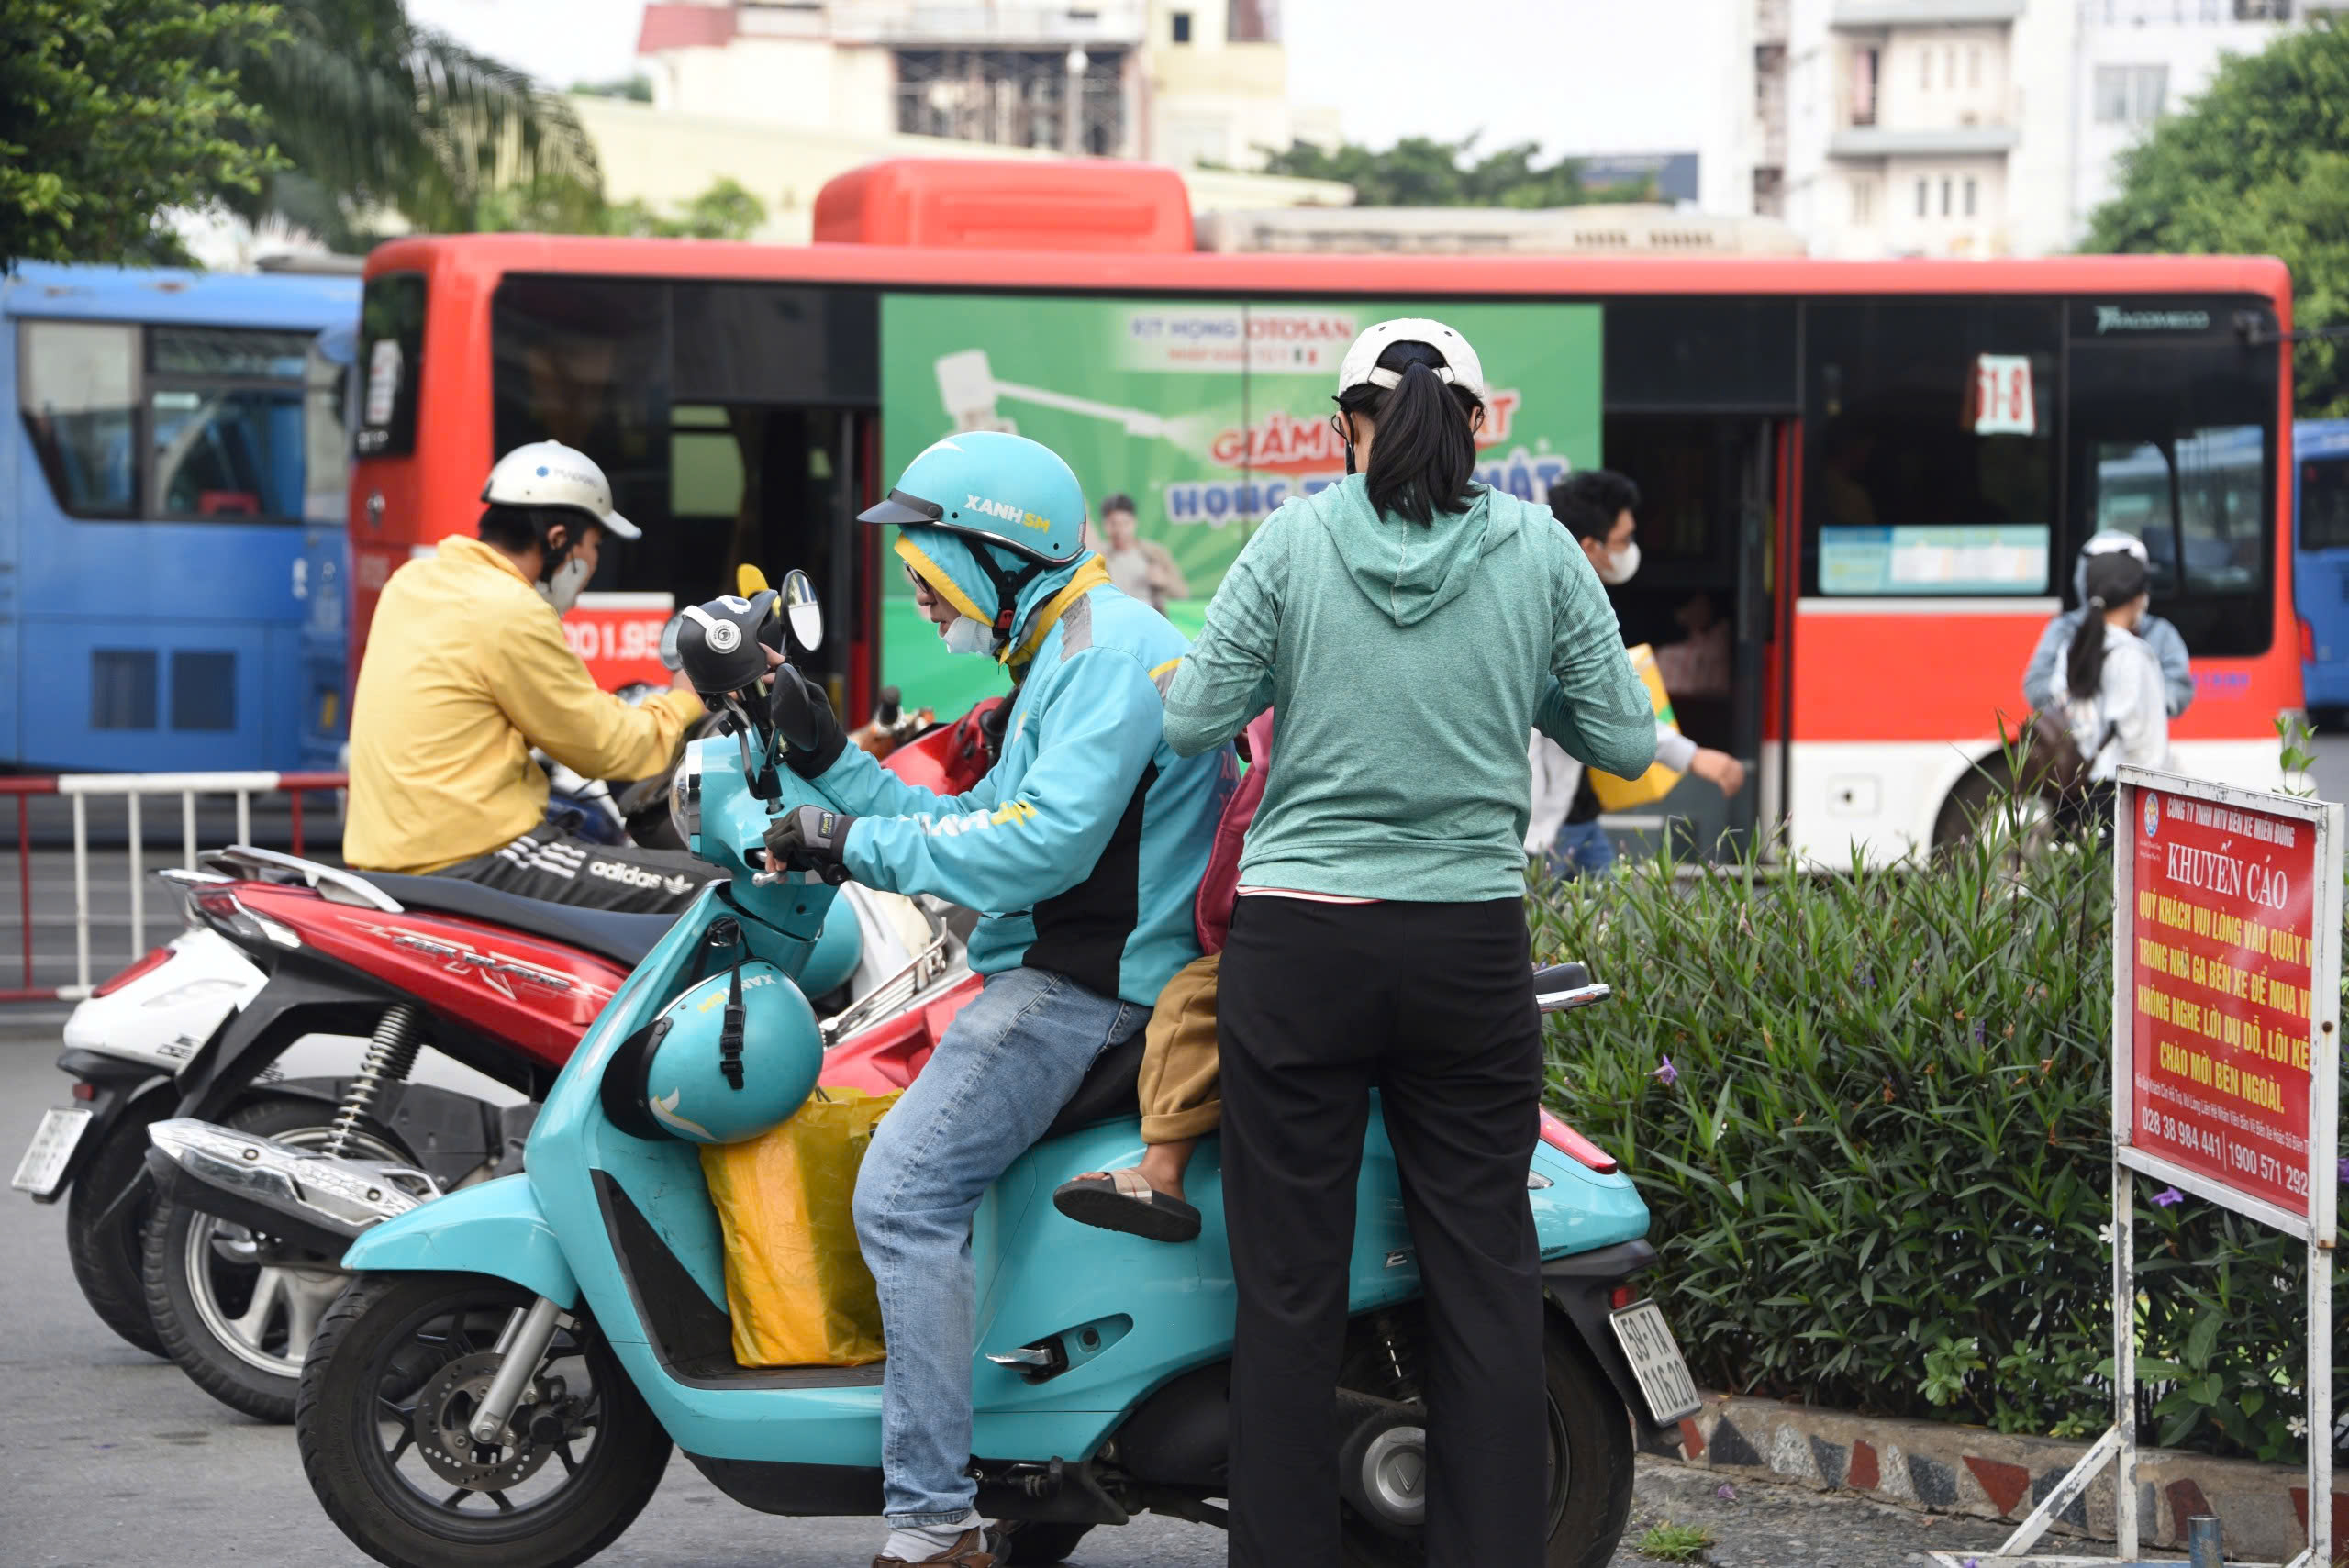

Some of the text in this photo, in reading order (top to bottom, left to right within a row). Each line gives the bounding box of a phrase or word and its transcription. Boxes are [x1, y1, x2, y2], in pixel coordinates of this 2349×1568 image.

[963, 494, 1024, 524] XANH
[589, 861, 662, 889] adidas
[2166, 840, 2288, 910] KHUYẾN CÁO
[2139, 887, 2157, 922] QUÝ
[2158, 894, 2191, 932] KHÁCH
[2193, 905, 2211, 938] VUI
[2212, 906, 2243, 948] LÒNG
[2244, 917, 2267, 955] VÀO
[2138, 936, 2167, 974] TRONG
[2192, 955, 2207, 986] GA
[2209, 953, 2231, 994] BẾN
[2232, 967, 2249, 1000] XE
[2250, 965, 2268, 1006] ĐỂ
[2268, 979, 2297, 1016] MUA
[2137, 984, 2169, 1023] KHÔNG
[2171, 996, 2200, 1033] NGHE
[2203, 1003, 2221, 1040] LỜI
[2224, 1014, 2241, 1053] DỤ
[2267, 1027, 2288, 1064] LÔI
[2160, 1040, 2286, 1114] CHÀO MỜI BÊN NGOÀI.
[2143, 1106, 2161, 1136] 028
[2163, 1115, 2176, 1141] 38
[2178, 1120, 2199, 1151] 984
[2201, 1129, 2221, 1161] 441
[2229, 1140, 2257, 1175] 1900
[2260, 1153, 2282, 1185] 571
[1620, 1310, 1672, 1362] 59-TA
[1642, 1359, 1695, 1415] 116.20
